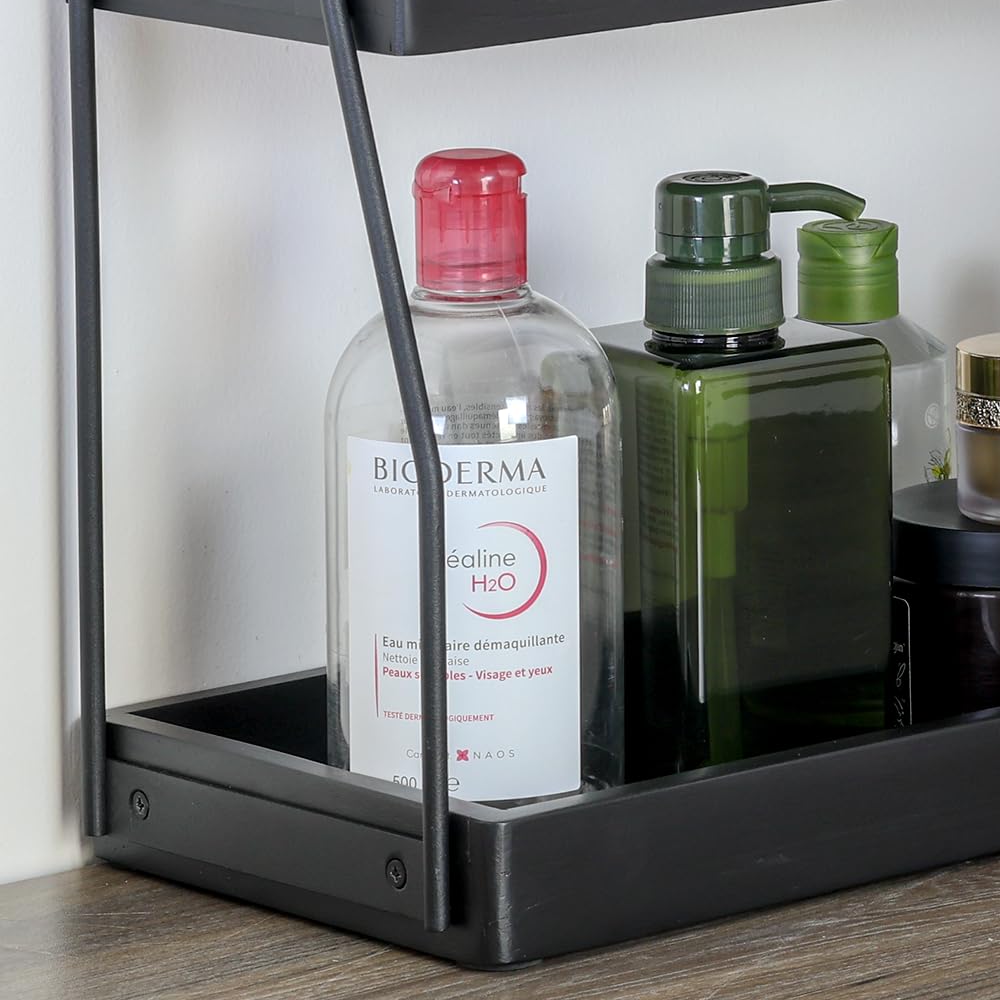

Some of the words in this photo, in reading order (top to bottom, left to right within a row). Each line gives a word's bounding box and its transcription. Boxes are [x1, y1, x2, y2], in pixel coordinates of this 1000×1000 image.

[374, 486, 416, 496] LABORAT
[447, 485, 547, 498] DERMATOLOGIQUE
[447, 549, 516, 568] éaline
[383, 636, 403, 649] Eau
[407, 640, 470, 651] miaire
[474, 634, 565, 651] démaquillante
[383, 653, 418, 665] Nettoie
[447, 656, 470, 666] aise
[383, 666, 412, 679] Peaux
[415, 671, 466, 680] sbles
[475, 669, 512, 681] Visage
[515, 668, 526, 678] et
[528, 665, 553, 678] yeux
[473, 749, 515, 760] NAOS
